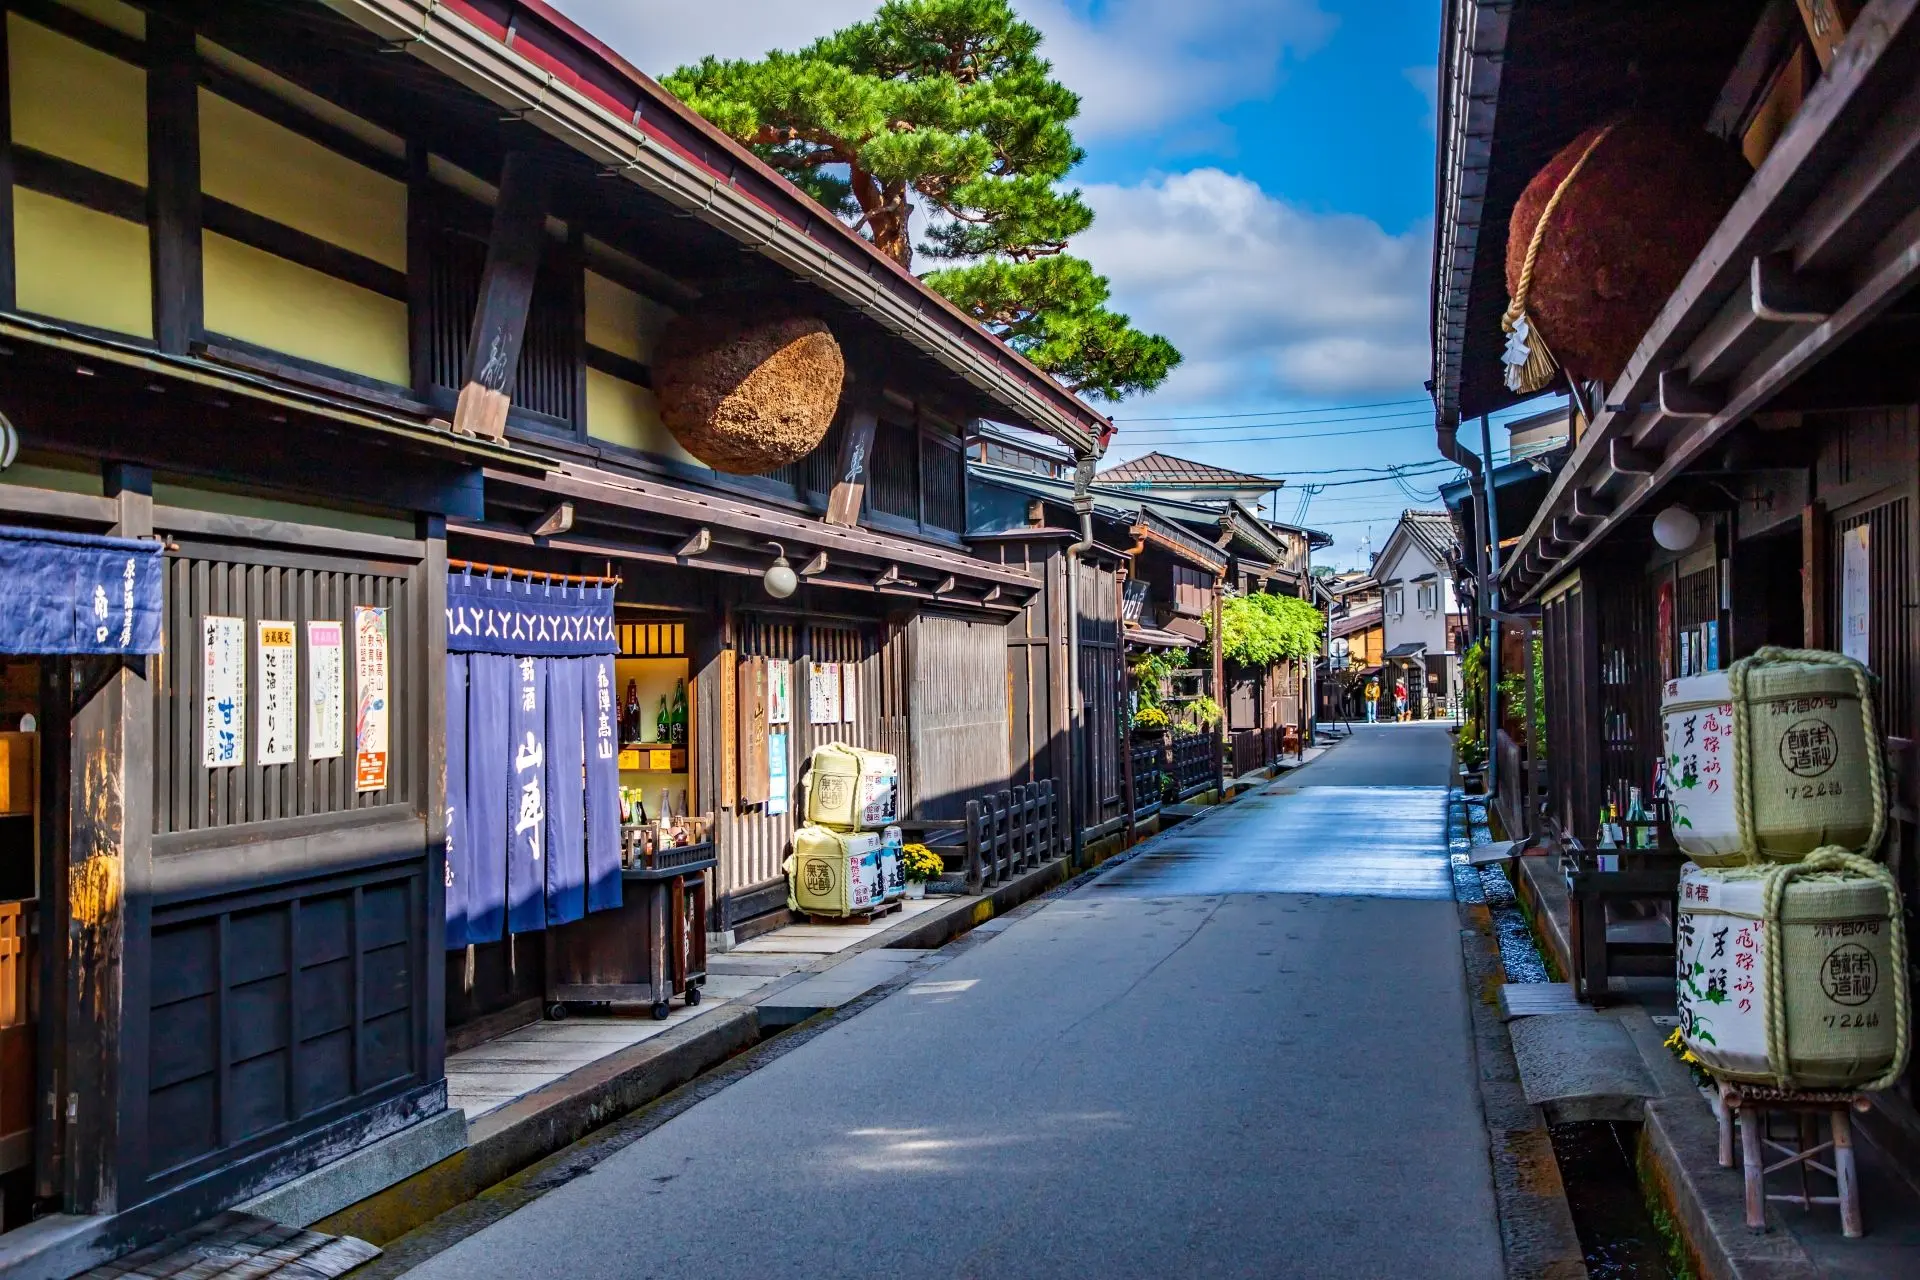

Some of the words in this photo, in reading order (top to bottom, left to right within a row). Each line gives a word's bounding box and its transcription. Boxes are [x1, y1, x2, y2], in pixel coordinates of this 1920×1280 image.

[218, 696, 235, 761] 甘酒
[599, 663, 613, 759] 飛騨高山
[515, 731, 544, 861] 山車
